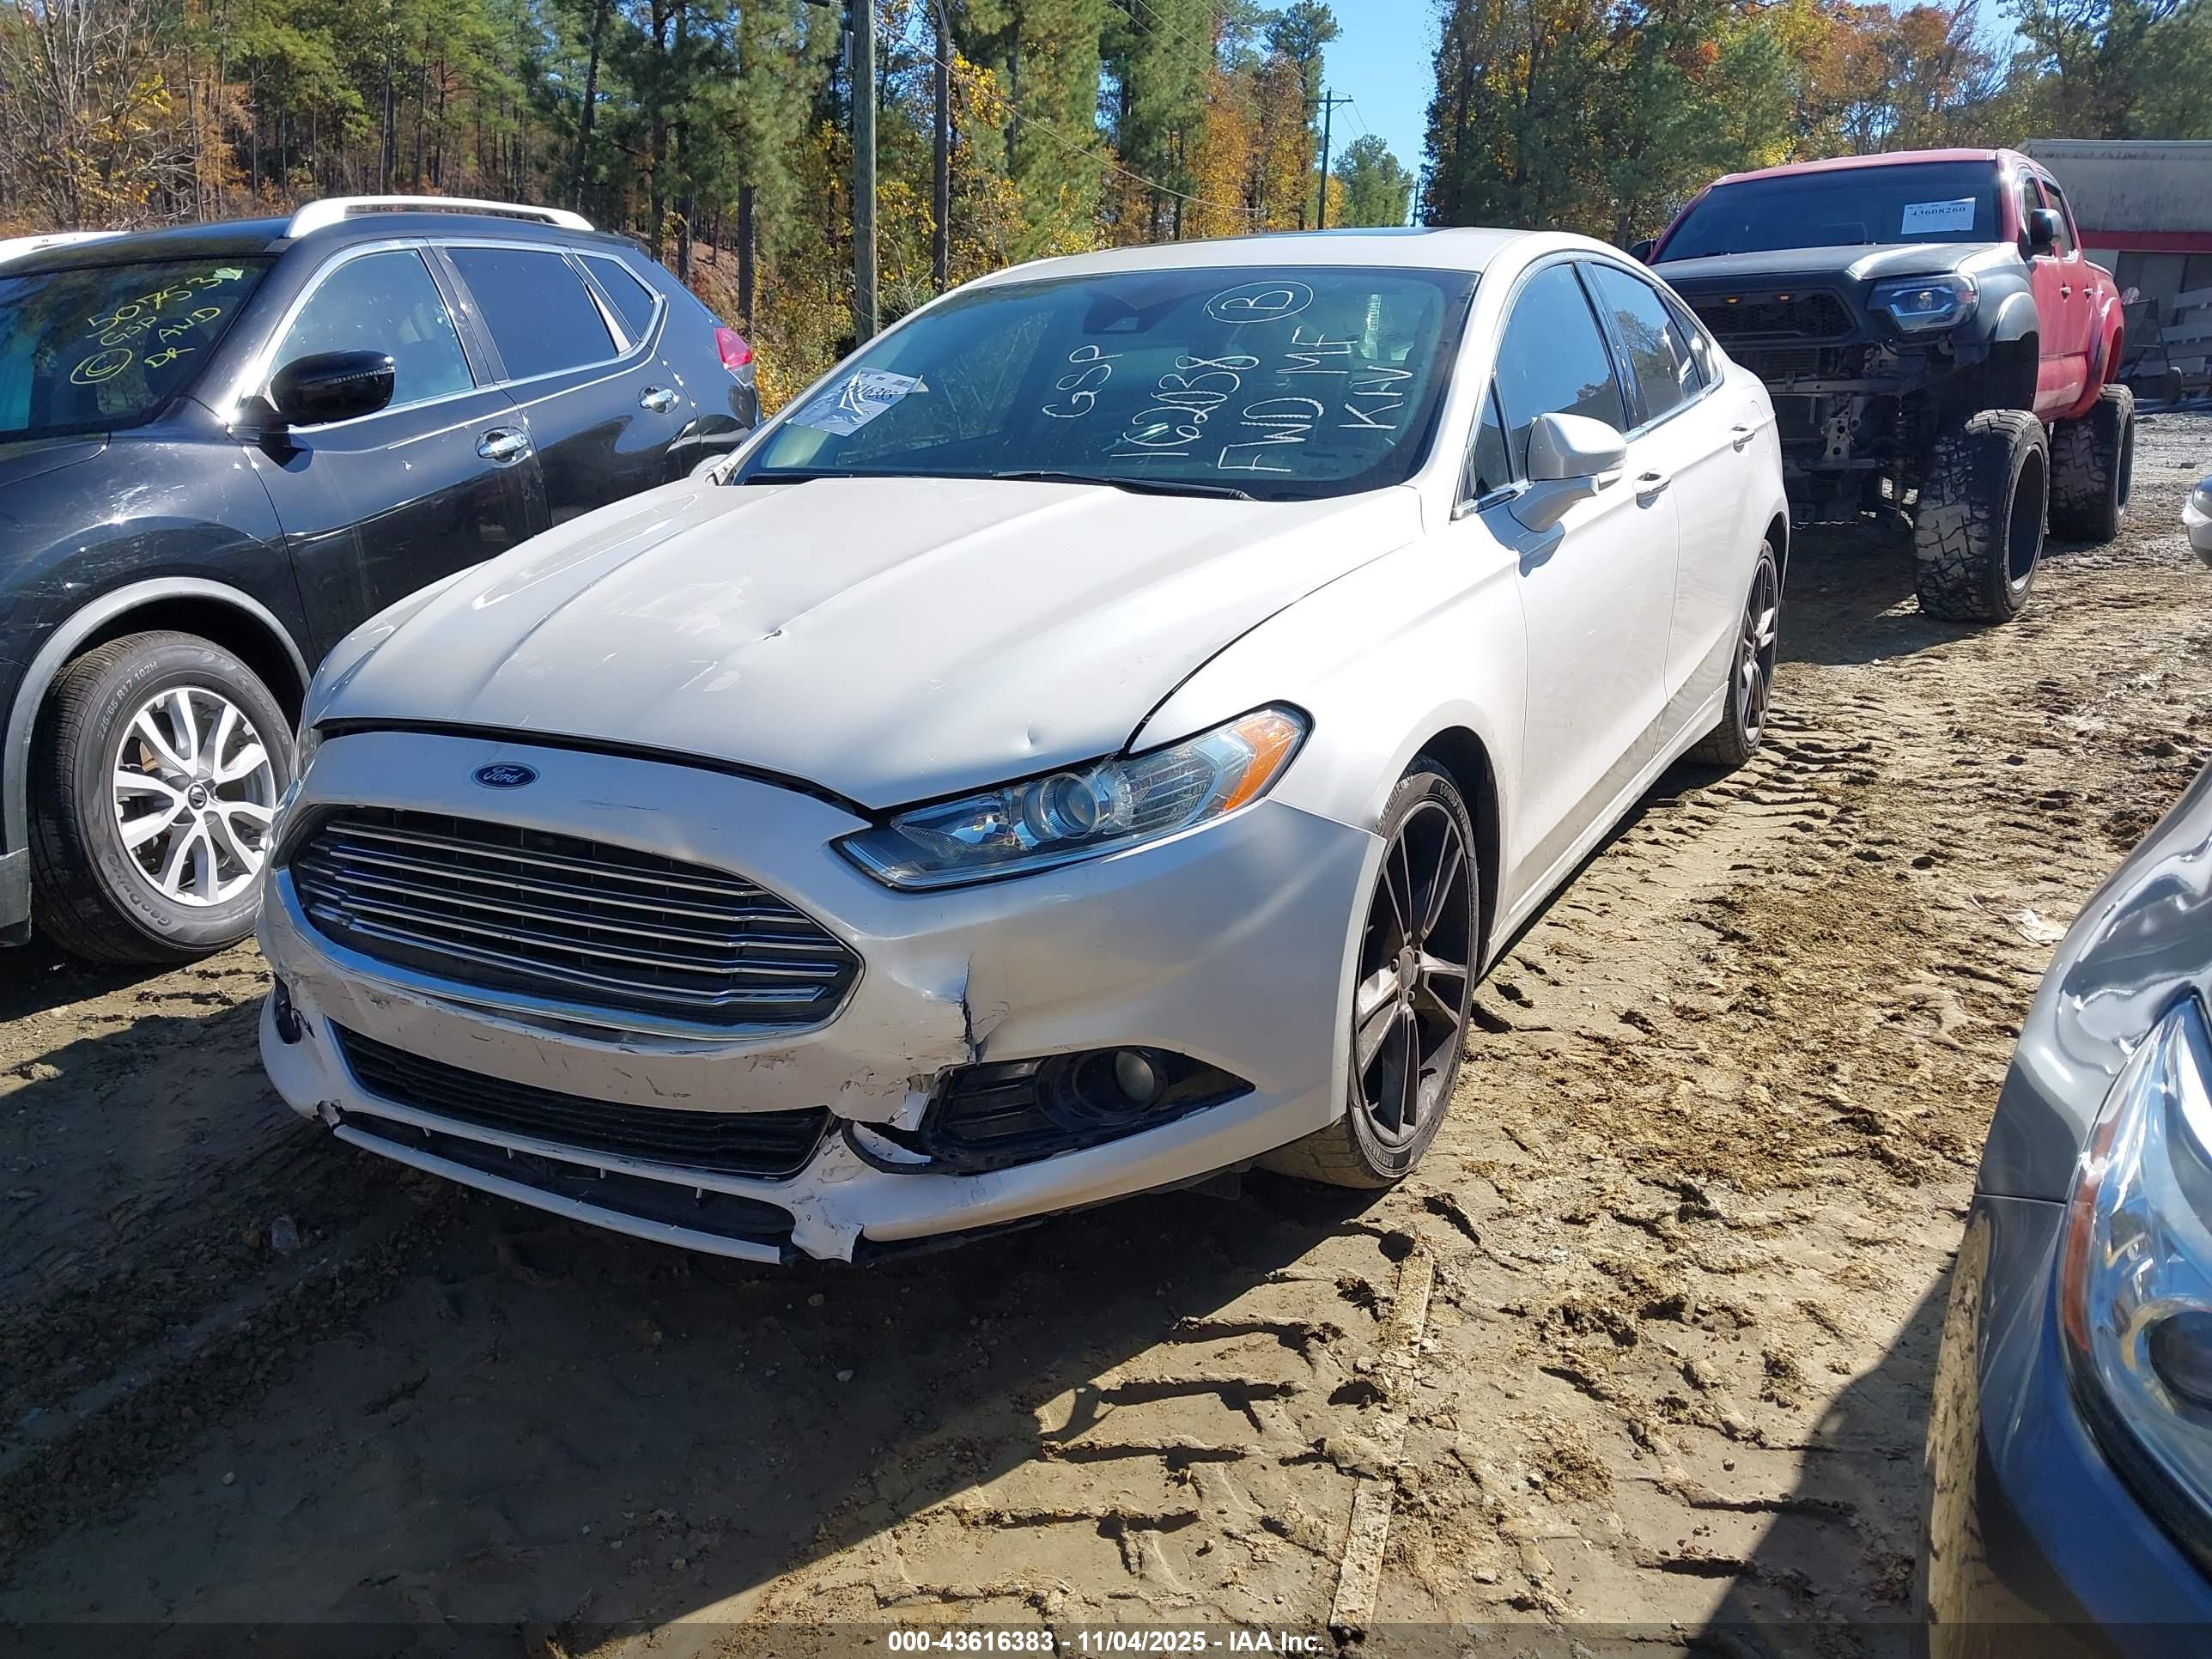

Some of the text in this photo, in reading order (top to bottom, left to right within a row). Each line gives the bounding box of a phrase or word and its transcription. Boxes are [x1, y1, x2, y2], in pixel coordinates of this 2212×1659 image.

[1910, 206, 1966, 216] 43608260
[100, 316, 157, 346] GSP
[158, 307, 221, 343] AWD
[143, 347, 196, 368] DR
[1042, 345, 1123, 417] GSP
[1110, 355, 1260, 458] 162038
[1218, 397, 1324, 473] FWD
[96, 660, 159, 741] 225/65 R17 102H
[483, 766, 524, 783] Ford
